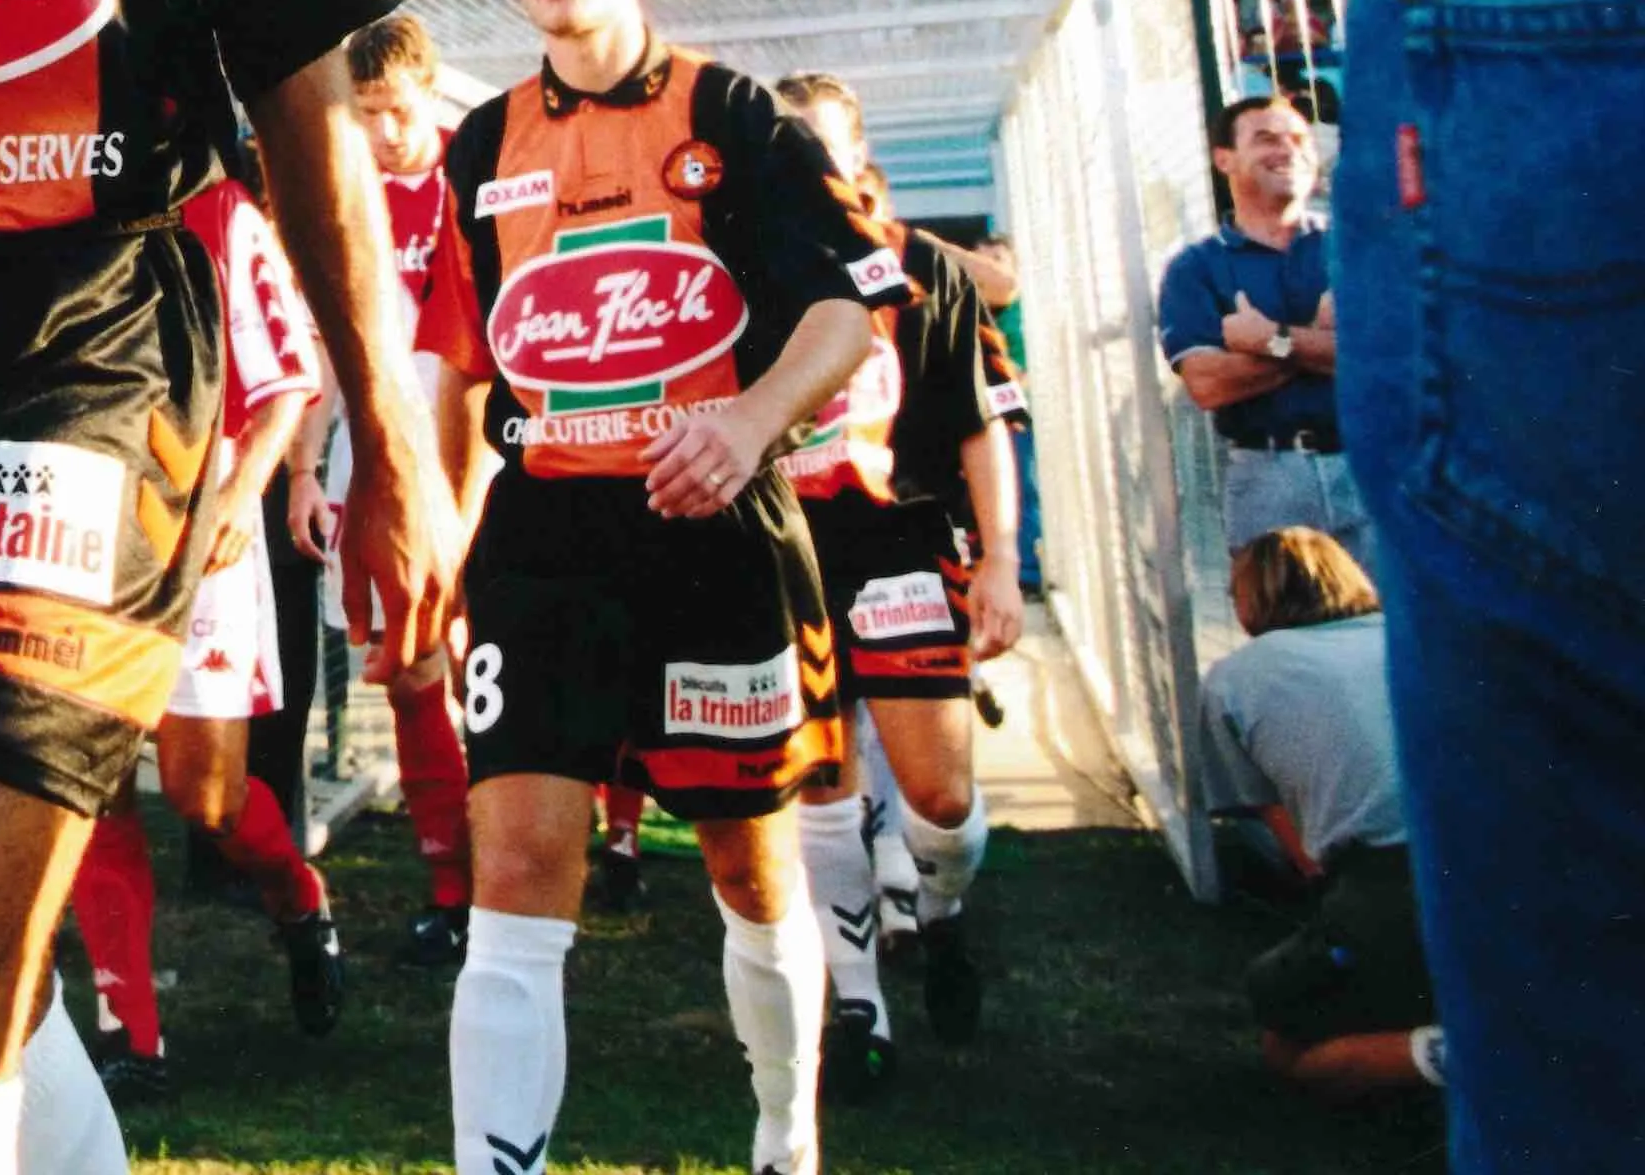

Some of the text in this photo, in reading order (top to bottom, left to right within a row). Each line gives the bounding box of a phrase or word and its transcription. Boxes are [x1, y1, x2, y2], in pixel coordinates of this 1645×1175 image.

[499, 265, 713, 363] jean Floc'h
[466, 642, 504, 734] 8
[670, 679, 792, 727] la trinitain
